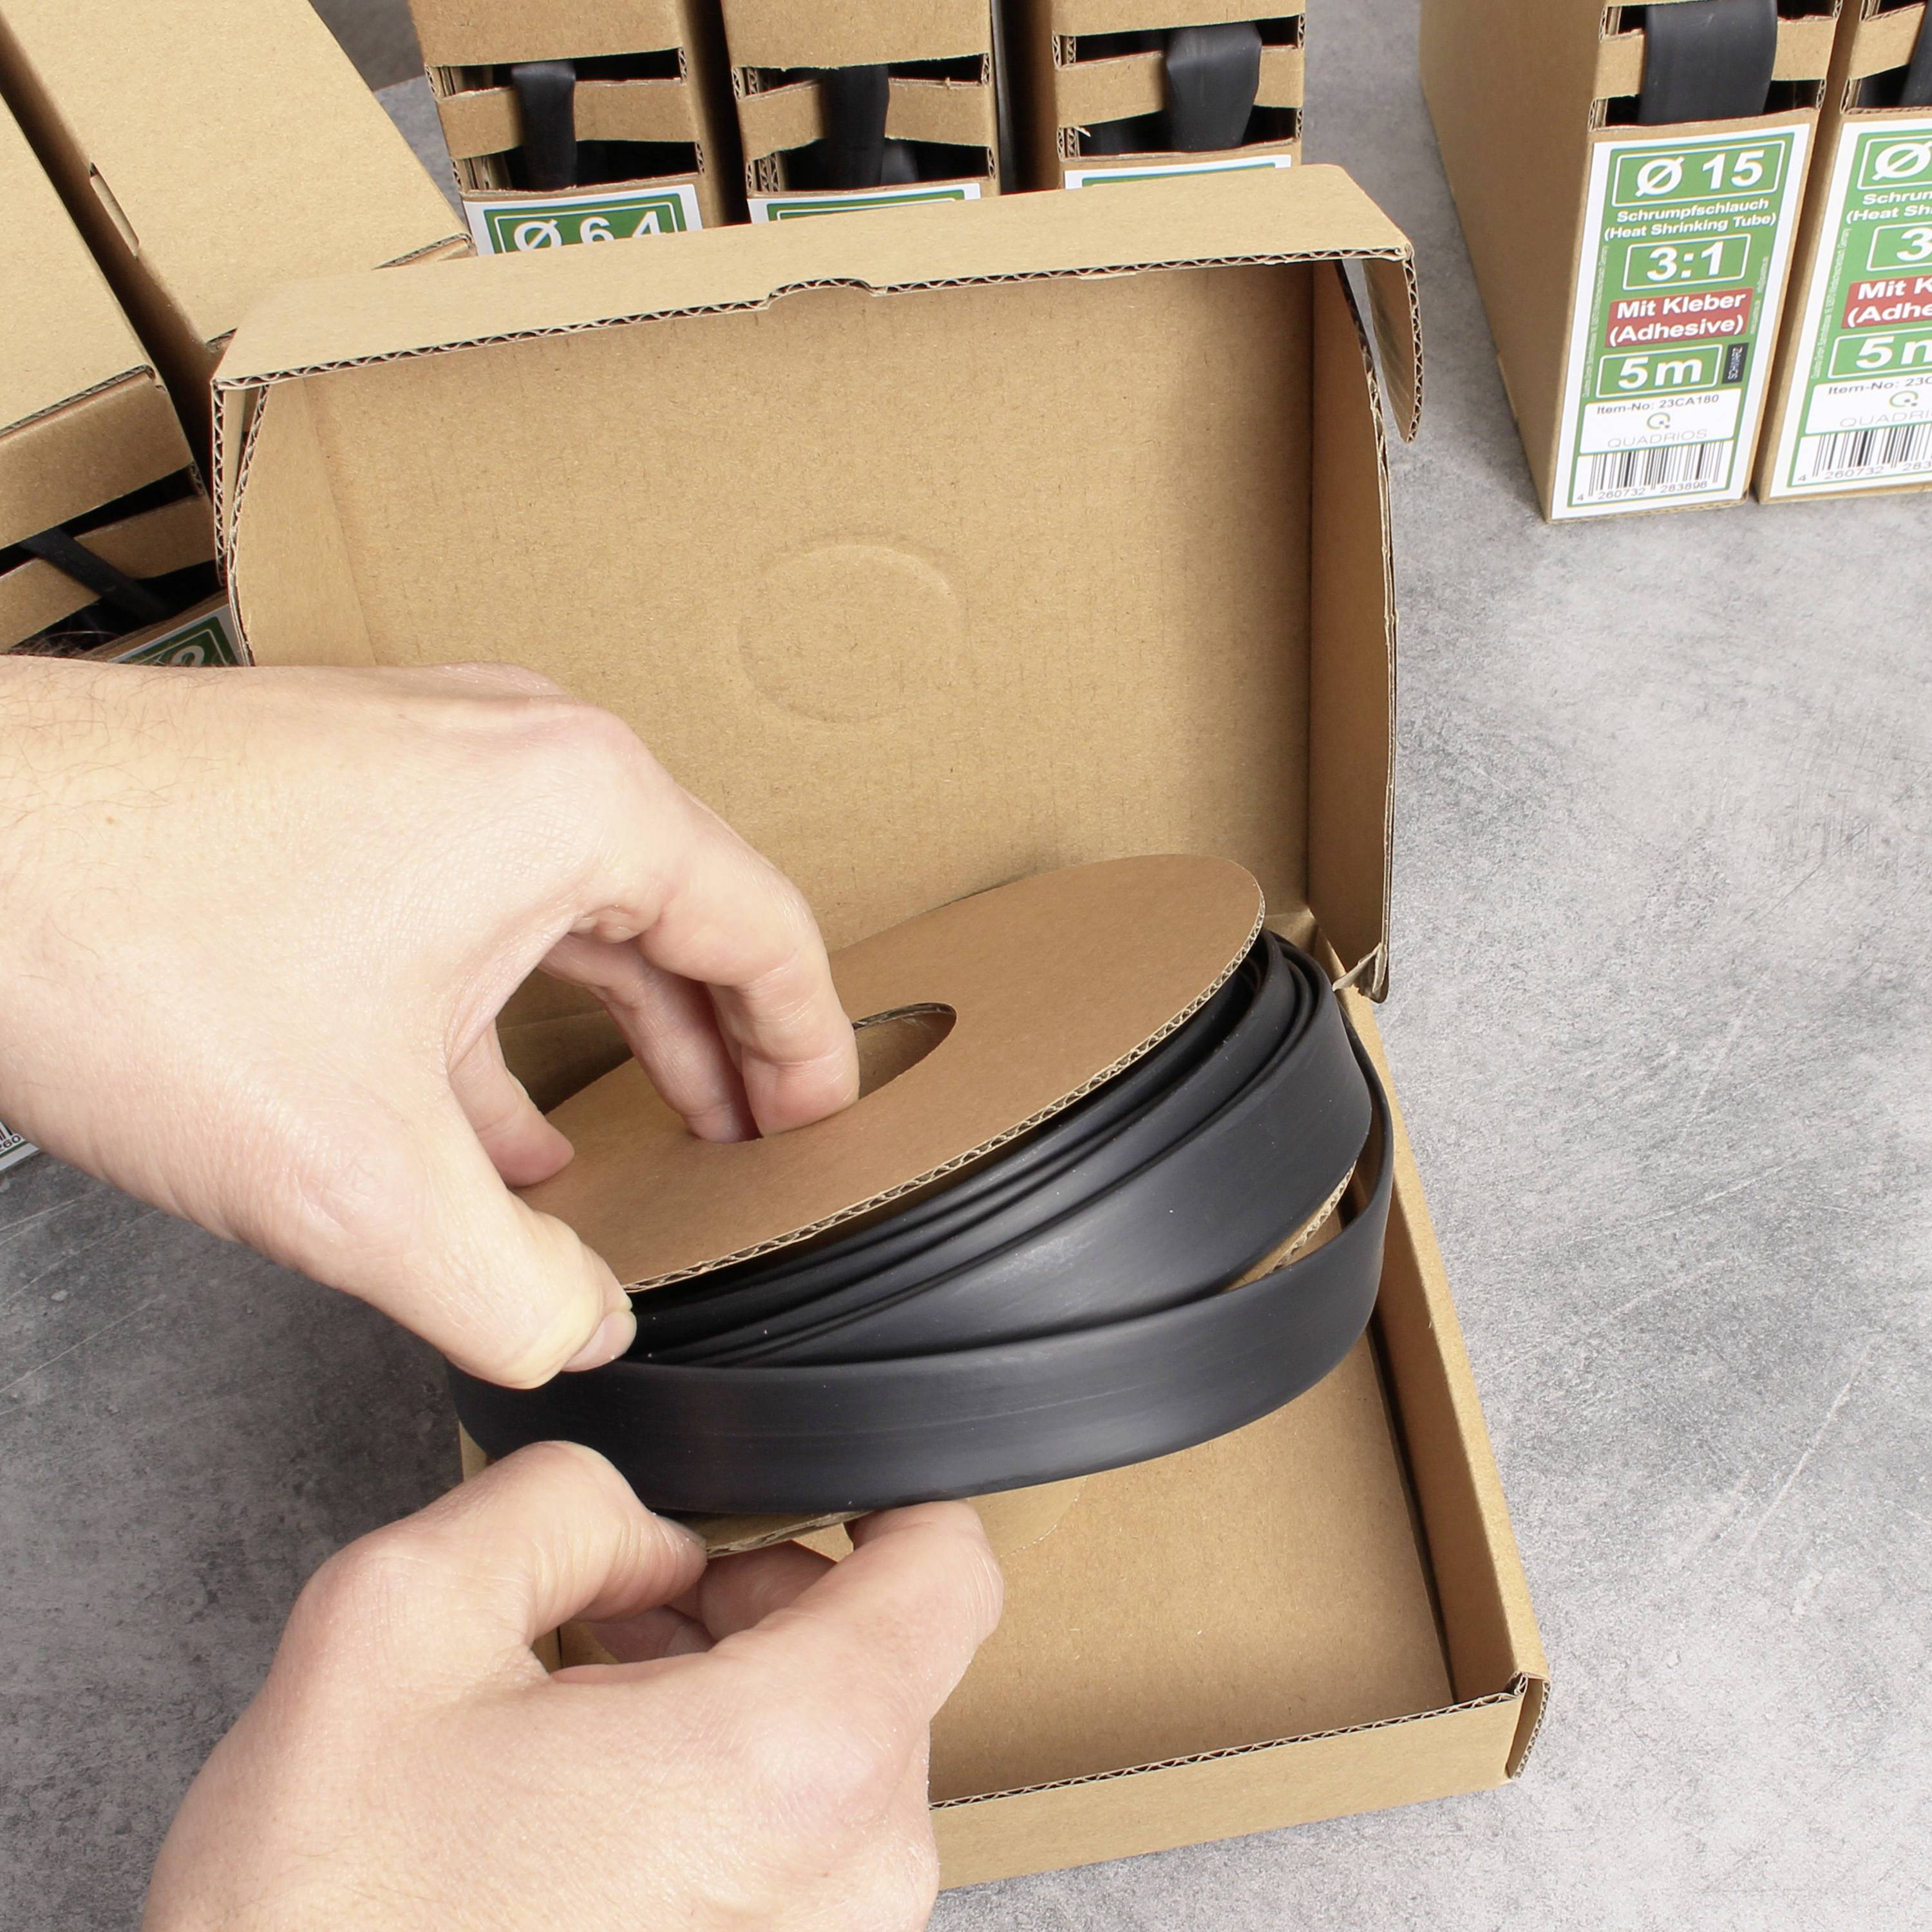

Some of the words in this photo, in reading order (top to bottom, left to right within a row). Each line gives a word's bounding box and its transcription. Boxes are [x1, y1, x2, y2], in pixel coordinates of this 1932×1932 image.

[1871, 140, 1932, 181] Ø
[1634, 156, 1685, 197] Ø
[1702, 150, 1765, 190] 15
[1616, 198, 1769, 223] Schrumpfschlauch
[1846, 207, 1899, 224] (Heat
[1904, 204, 1932, 216] Sh
[1604, 225, 1647, 241] (Heat
[1651, 218, 1728, 236] Shrinking
[1732, 213, 1777, 228] Tube)
[1647, 241, 1724, 281] 3:1
[1857, 280, 1907, 300] Mit
[1617, 299, 1656, 319] Mit
[1662, 294, 1747, 315] Kleber
[1609, 314, 1744, 347] (Adhesive)
[1828, 381, 1899, 395] Item-No:
[1597, 402, 1654, 415] Item-No:
[1658, 394, 1719, 408] 23CA180
[1839, 410, 1932, 428] QUADRI
[1607, 429, 1708, 448] QUADRIOS
[1824, 466, 1884, 480] 260732
[1598, 488, 1645, 500] 260732
